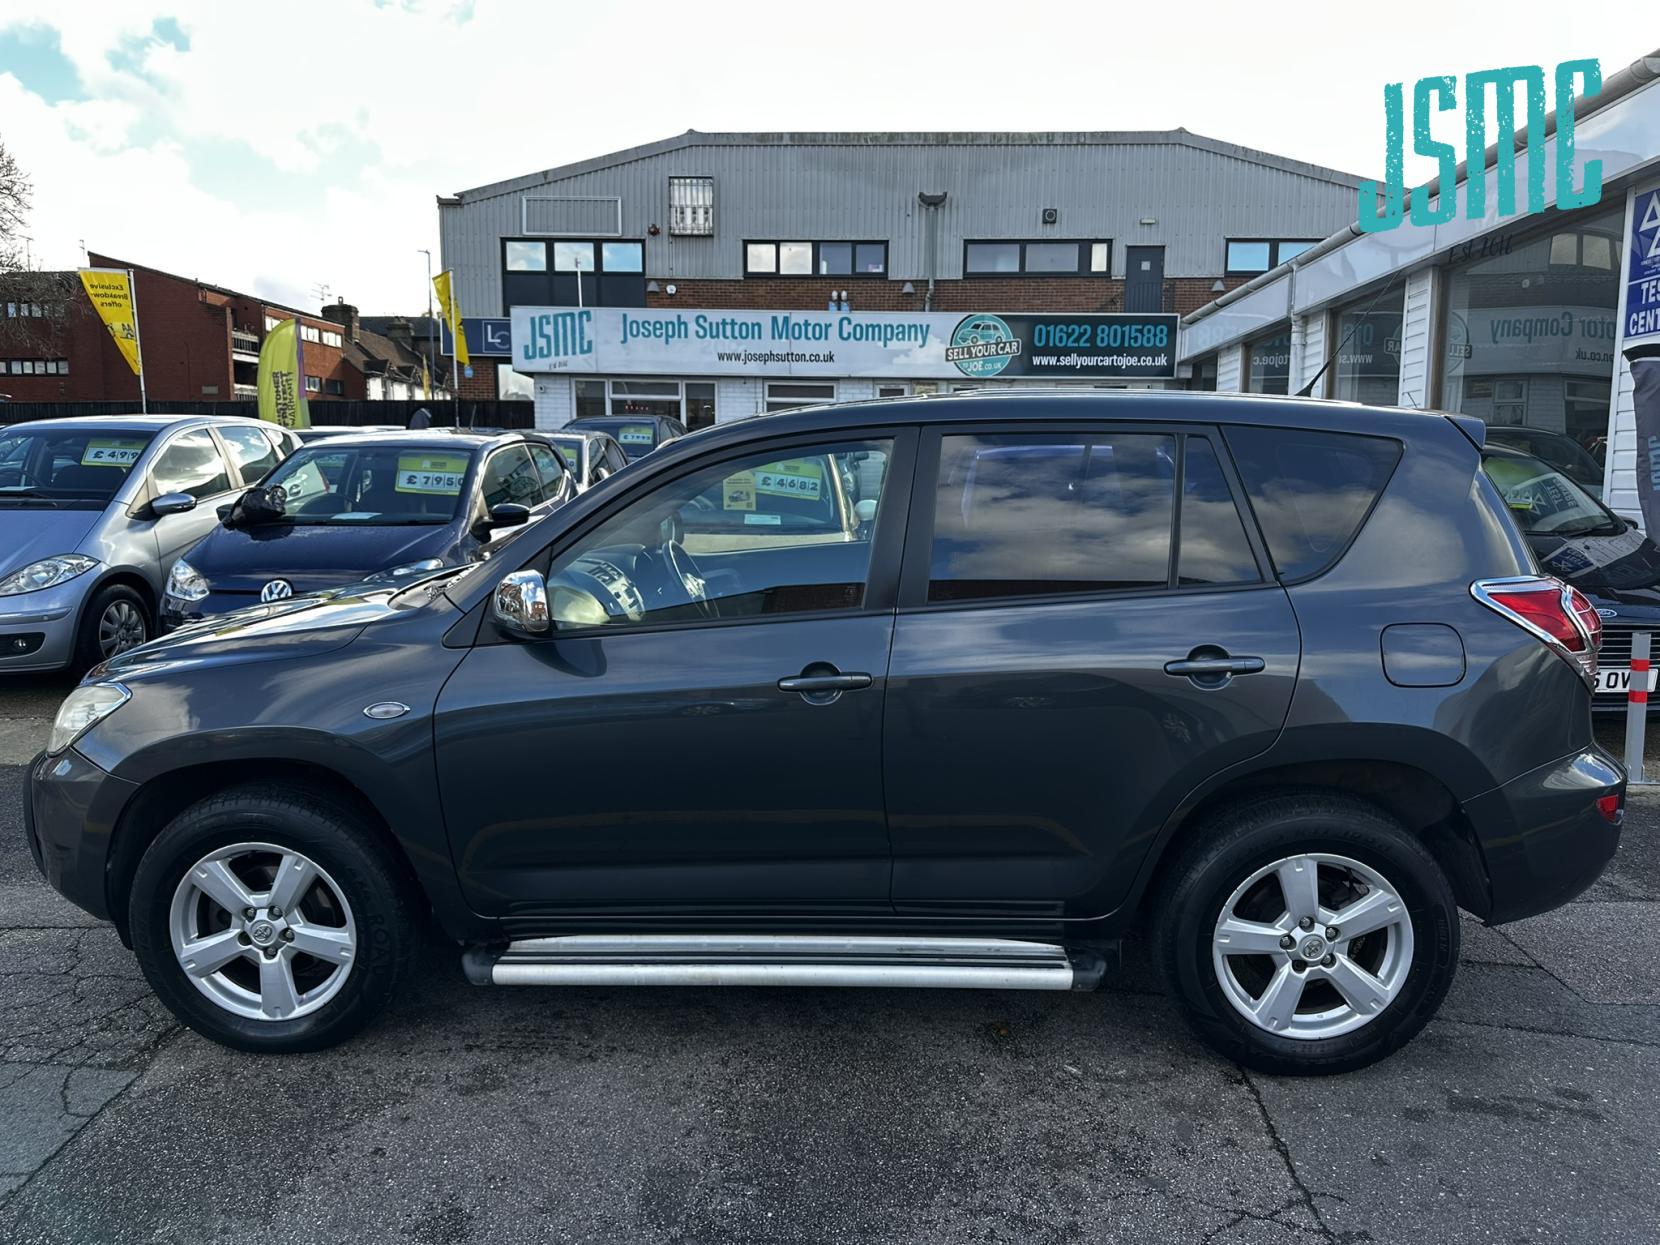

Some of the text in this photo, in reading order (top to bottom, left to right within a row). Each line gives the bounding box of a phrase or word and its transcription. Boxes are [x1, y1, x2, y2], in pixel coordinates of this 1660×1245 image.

[1641, 280, 1660, 304] TES
[620, 313, 930, 348] Joseph Sutton Motor Company
[1629, 308, 1660, 335] CENT
[523, 310, 593, 360] JSMC
[1033, 324, 1090, 347] 01622
[1096, 324, 1168, 348] 801588
[717, 351, 835, 365] www.josephsutton.co.uk
[947, 341, 1018, 361] SELL YOUR CAR
[1032, 353, 1167, 368] www.sellyourcartojoe.co.uk
[93, 450, 139, 459] £499
[761, 476, 818, 492] £4682
[1606, 671, 1630, 688] OV
